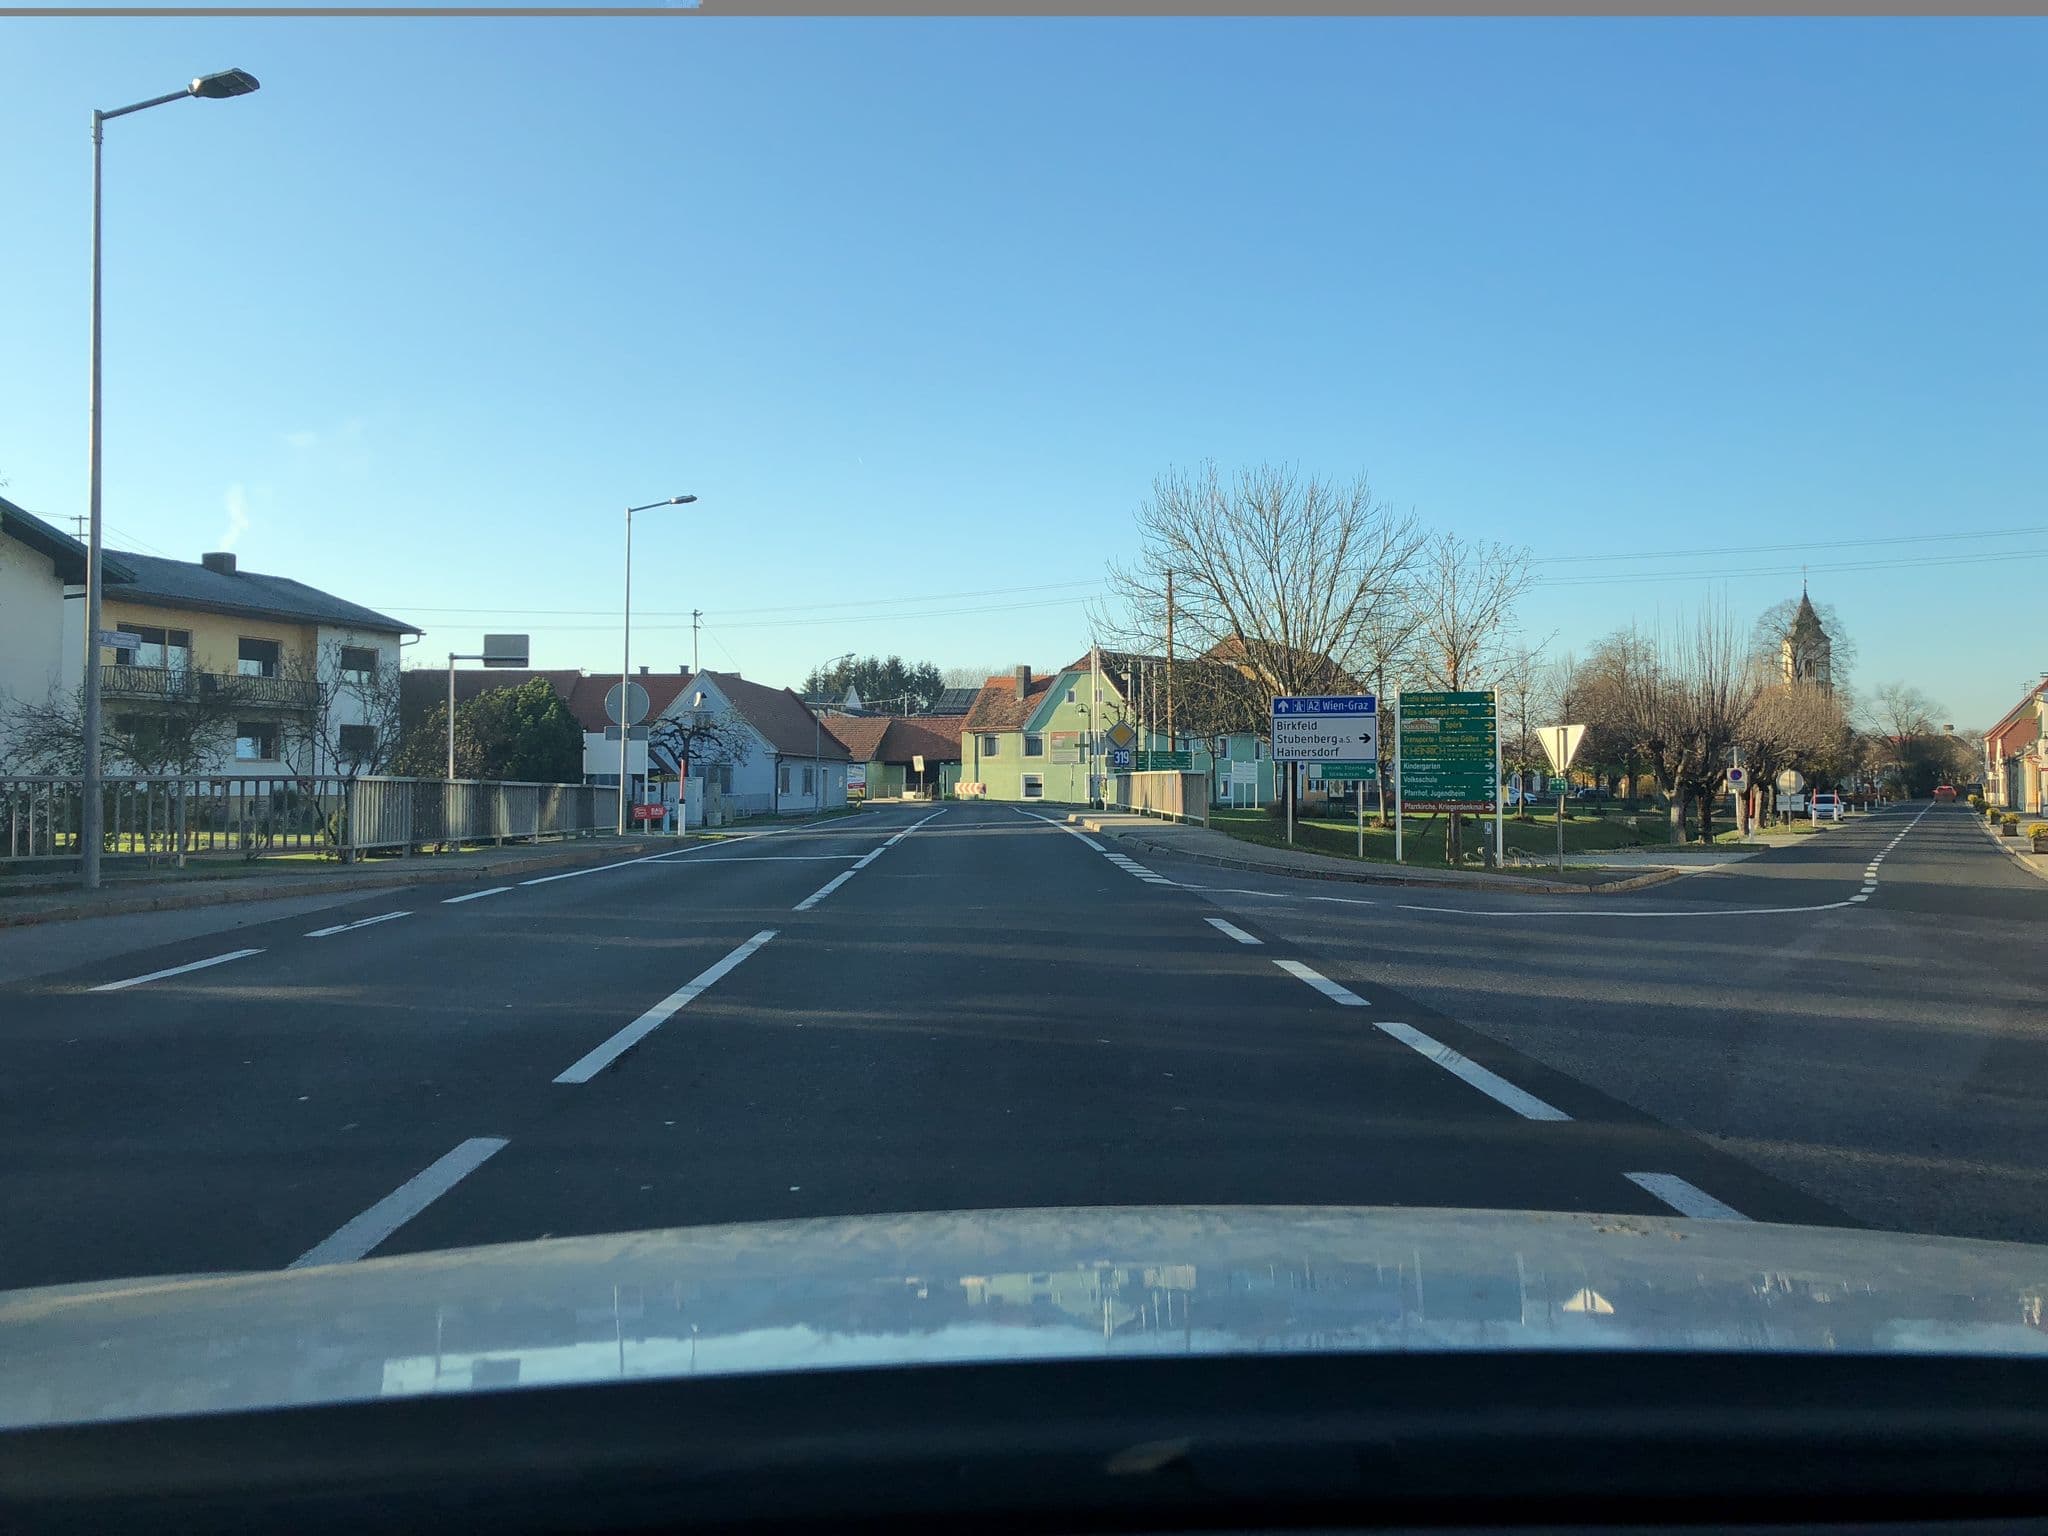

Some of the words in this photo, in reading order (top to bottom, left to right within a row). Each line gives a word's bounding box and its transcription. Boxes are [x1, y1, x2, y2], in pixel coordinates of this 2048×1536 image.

[1323, 701, 1368, 711] Wien-Graz
[1276, 721, 1318, 731] Birkfeld
[1277, 734, 1338, 745] Stubenberg
[1277, 747, 1340, 757] Hainersdorf
[1114, 752, 1129, 763] 319
[1403, 762, 1441, 771] Kindergarten
[1403, 775, 1438, 783] Volksschule
[1430, 789, 1466, 798] Jugendheim
[1438, 802, 1484, 811] Kriegerdenkmal
